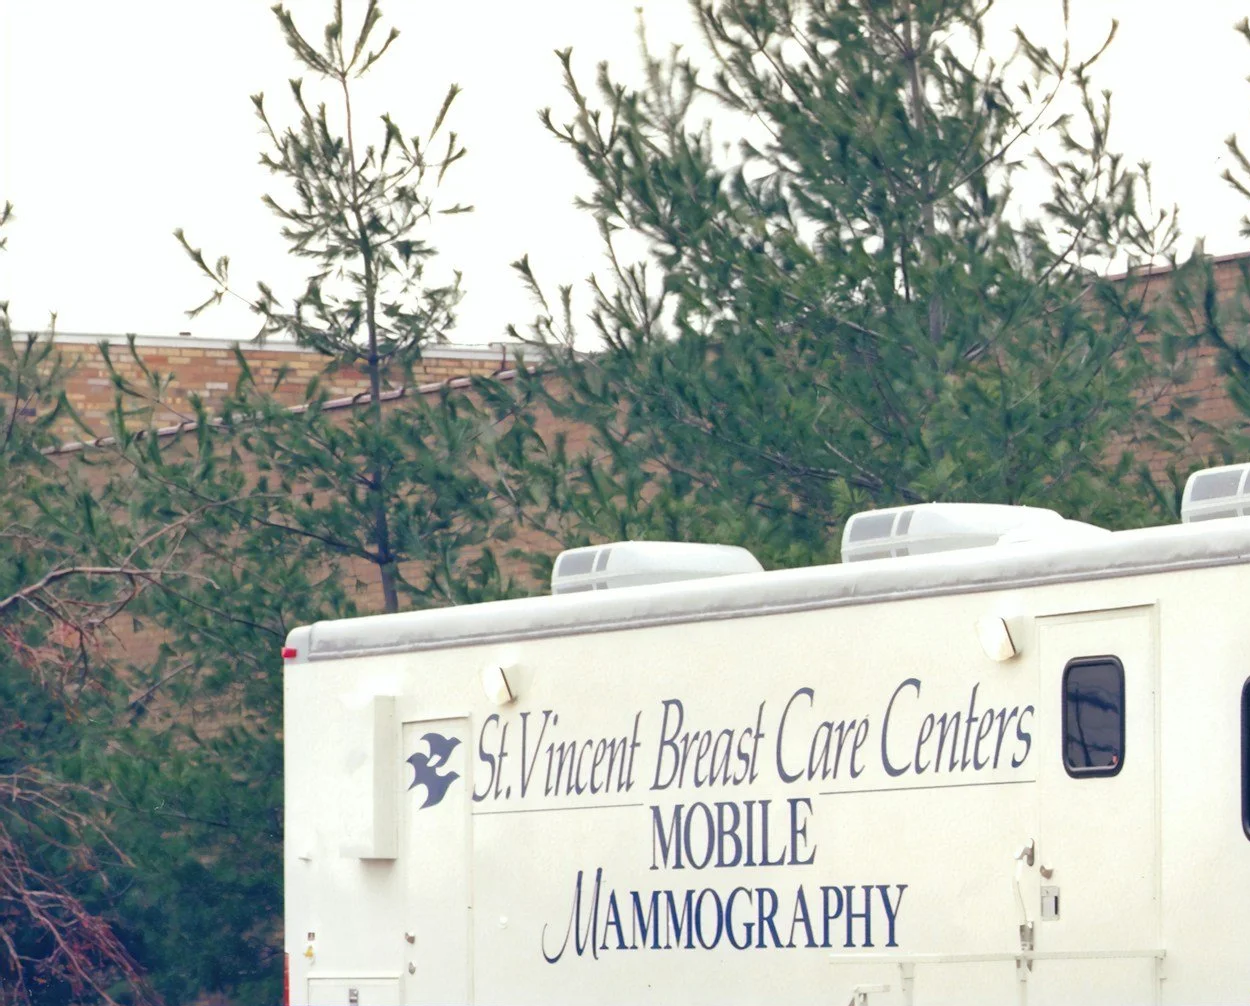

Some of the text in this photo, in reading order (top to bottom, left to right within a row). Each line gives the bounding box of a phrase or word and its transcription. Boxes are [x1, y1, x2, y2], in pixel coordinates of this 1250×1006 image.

[649, 698, 766, 791] Breast
[776, 687, 870, 785] Care
[881, 678, 1035, 777] Centers
[650, 797, 817, 870] MOBILE
[541, 867, 908, 964] MAMMOGRAPHY
